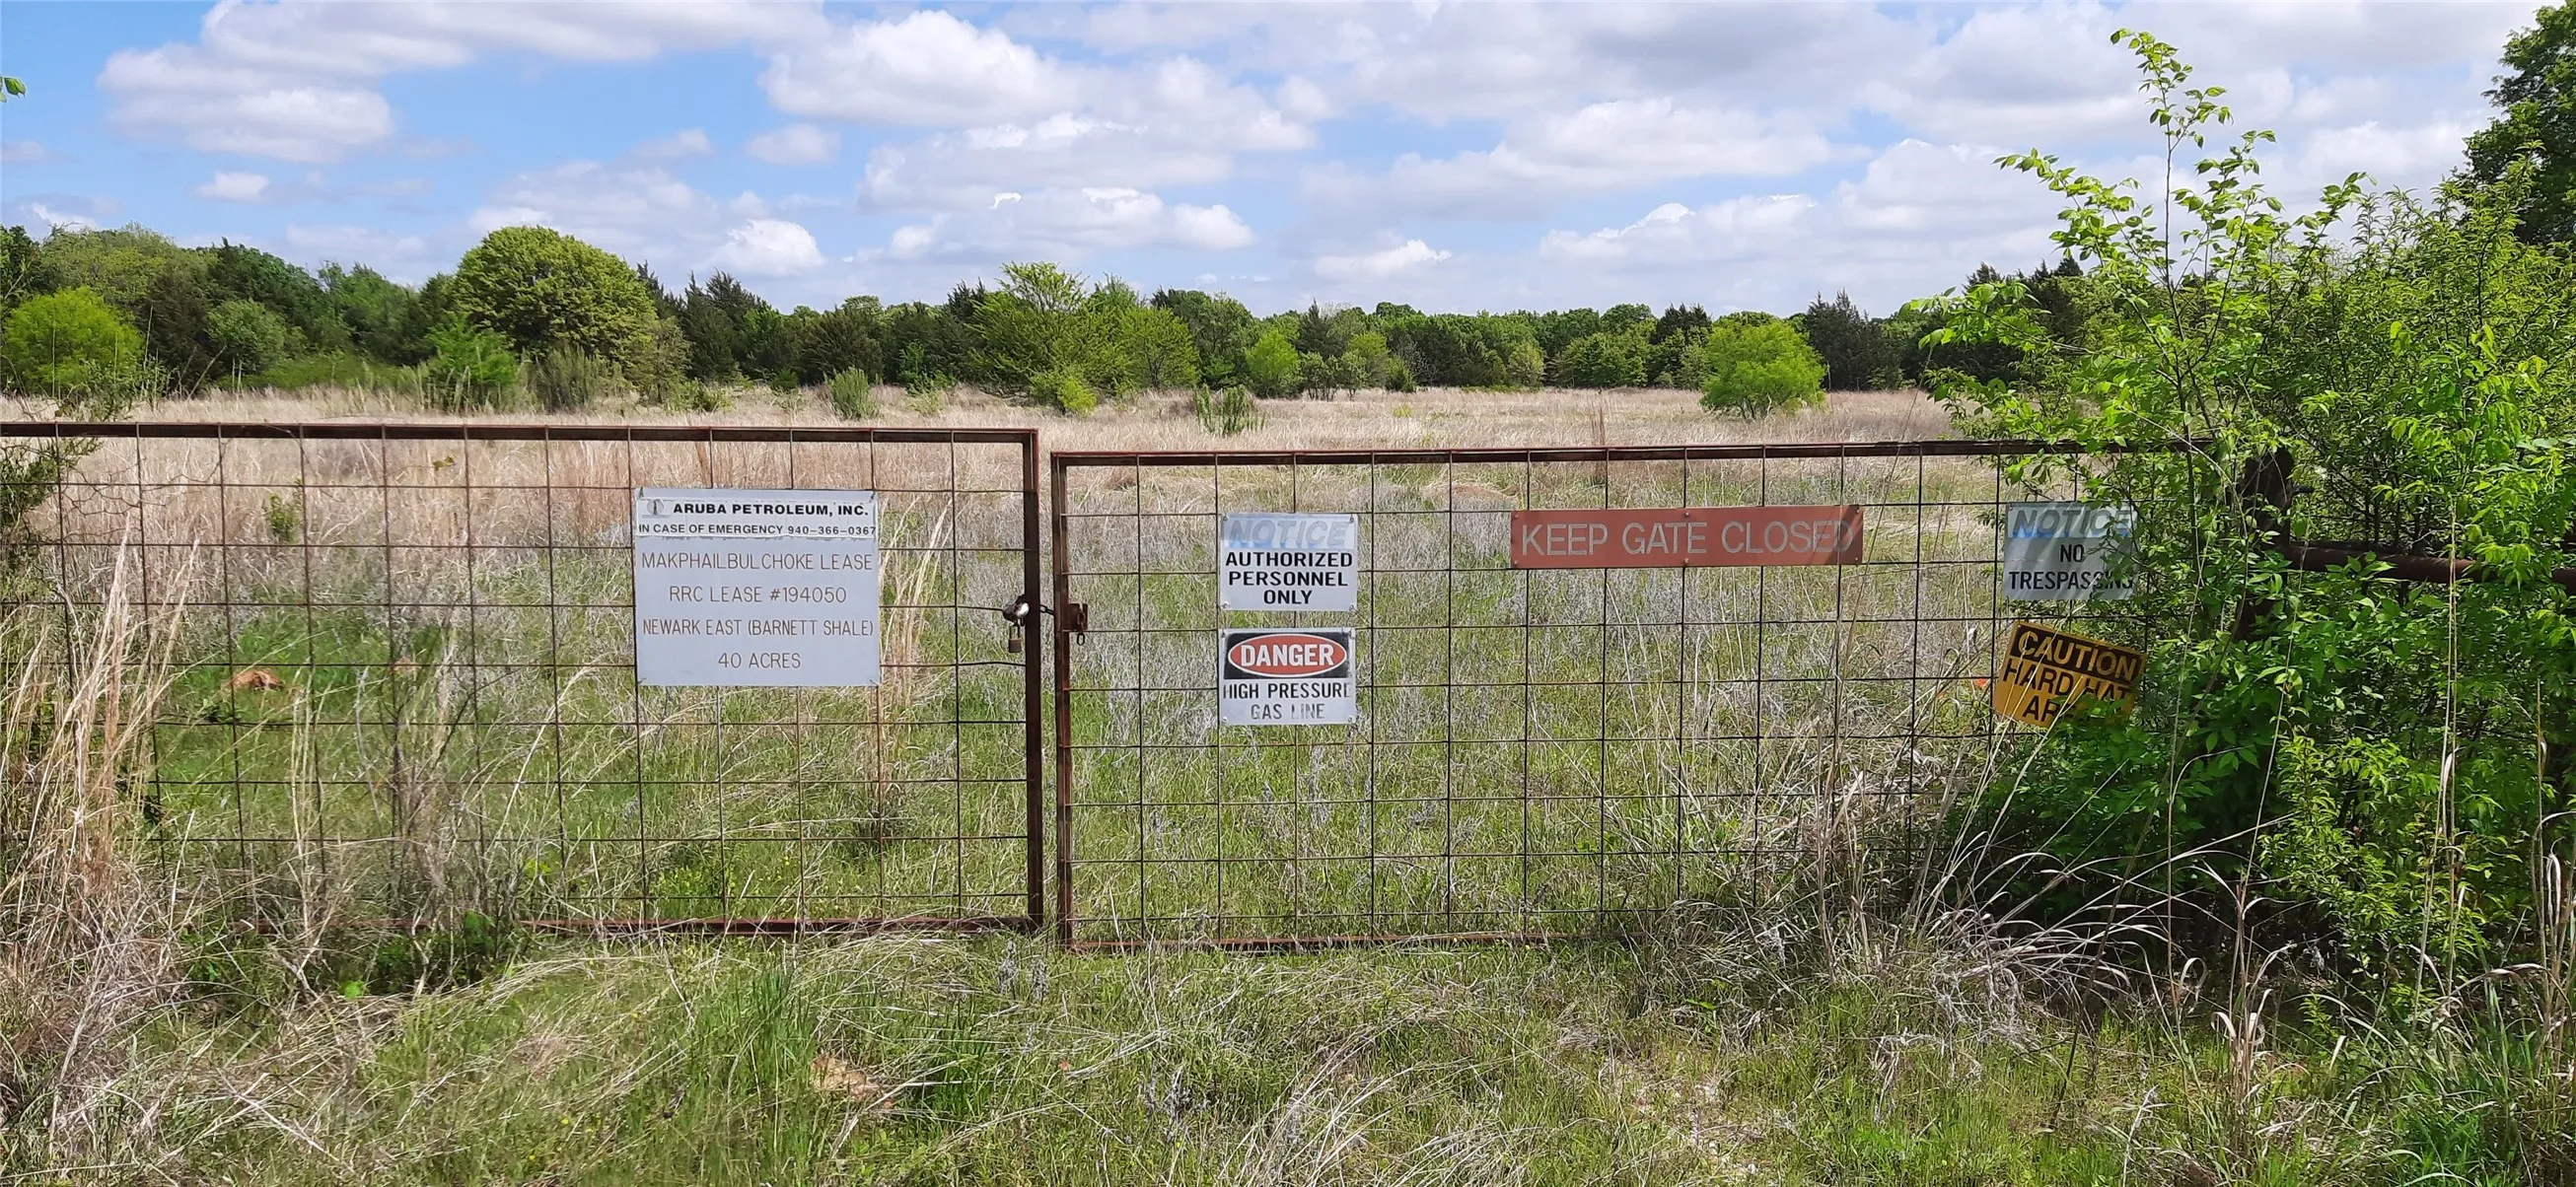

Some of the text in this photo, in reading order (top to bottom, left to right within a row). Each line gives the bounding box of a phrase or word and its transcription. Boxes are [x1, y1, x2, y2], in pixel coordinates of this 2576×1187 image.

[673, 503, 869, 518] ARUBA PETROLEUM, INC.
[639, 524, 876, 535] IN CASE OF EMERGENCY 940-366-0367
[1229, 520, 1349, 548] NOTICE
[1521, 520, 1854, 556] KEEP GATE CLOSED
[1225, 551, 1353, 568] AUTHORIZED
[2059, 543, 2085, 563] NO
[820, 554, 873, 571] LEASE
[1229, 571, 1348, 587] PERSONNEL
[669, 586, 847, 603] RRC LEASE #194050
[1263, 590, 1313, 604] ONLY
[643, 618, 874, 637] NEWARK EAST (BARNETT SHALE)
[718, 653, 801, 668] 40 ACRES
[1240, 644, 1334, 667] DANGER
[2018, 631, 2137, 680] CAUTION
[2002, 658, 2074, 696] HARD
[1223, 682, 1259, 699] HIGH
[1251, 703, 1282, 720] GAS
